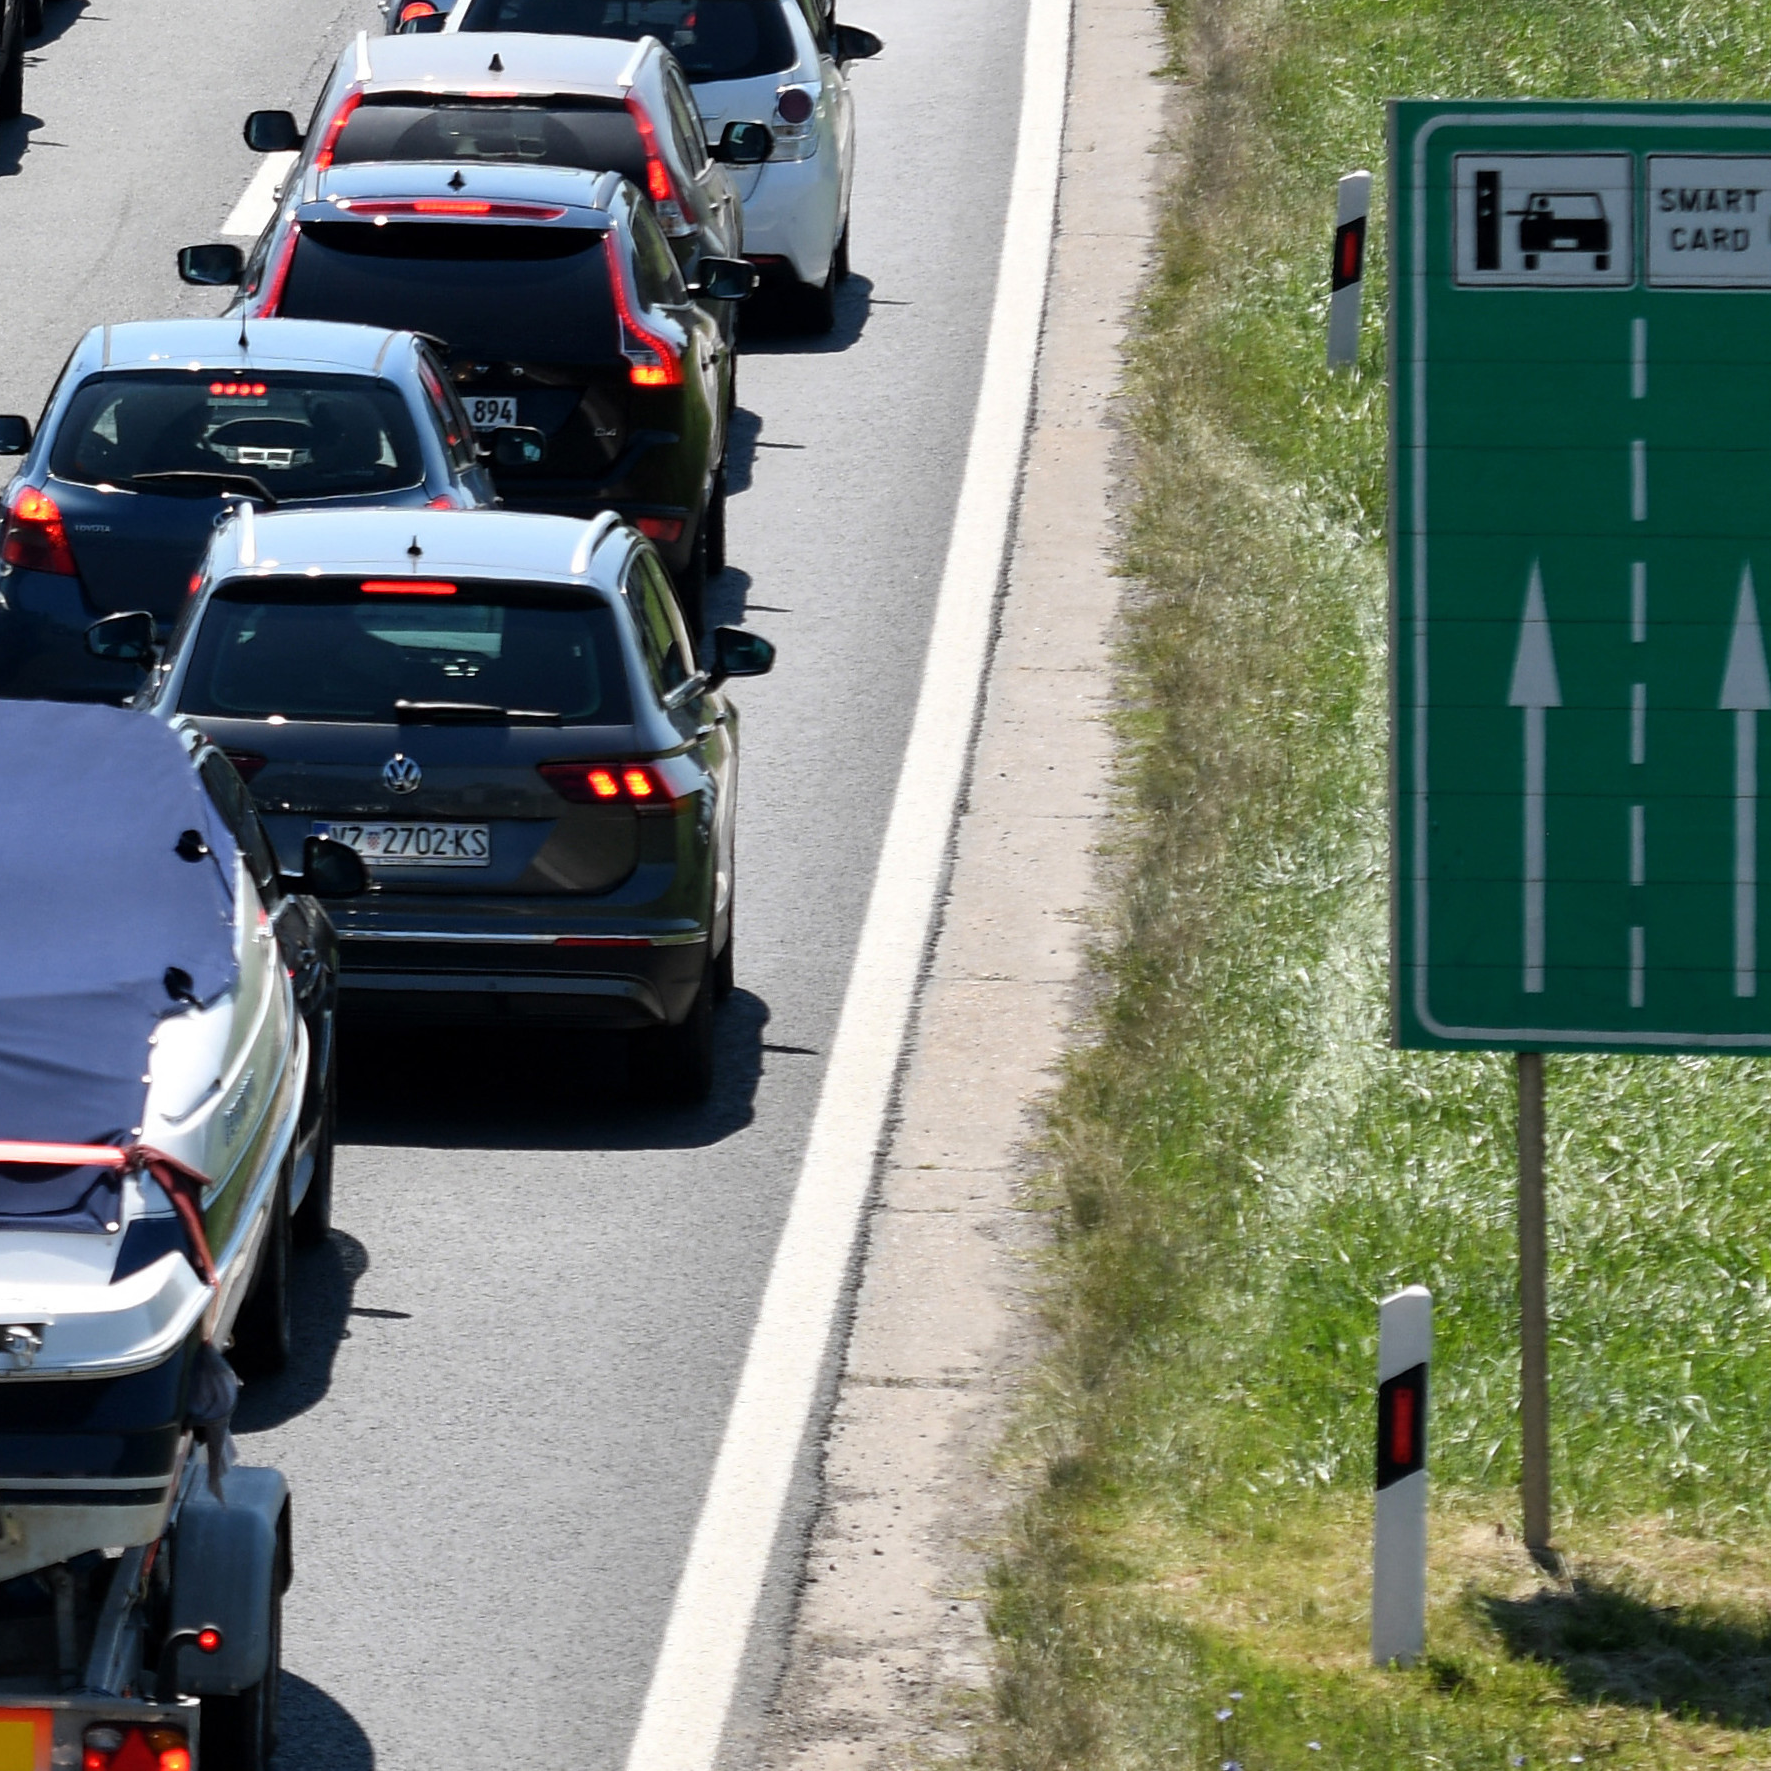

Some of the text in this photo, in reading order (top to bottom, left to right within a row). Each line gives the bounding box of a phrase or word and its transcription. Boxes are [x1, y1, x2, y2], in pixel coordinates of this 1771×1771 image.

[1660, 188, 1762, 212] SMART
[1672, 227, 1750, 252] CARD
[473, 399, 513, 423] 894
[383, 827, 487, 856] 2702-KS
